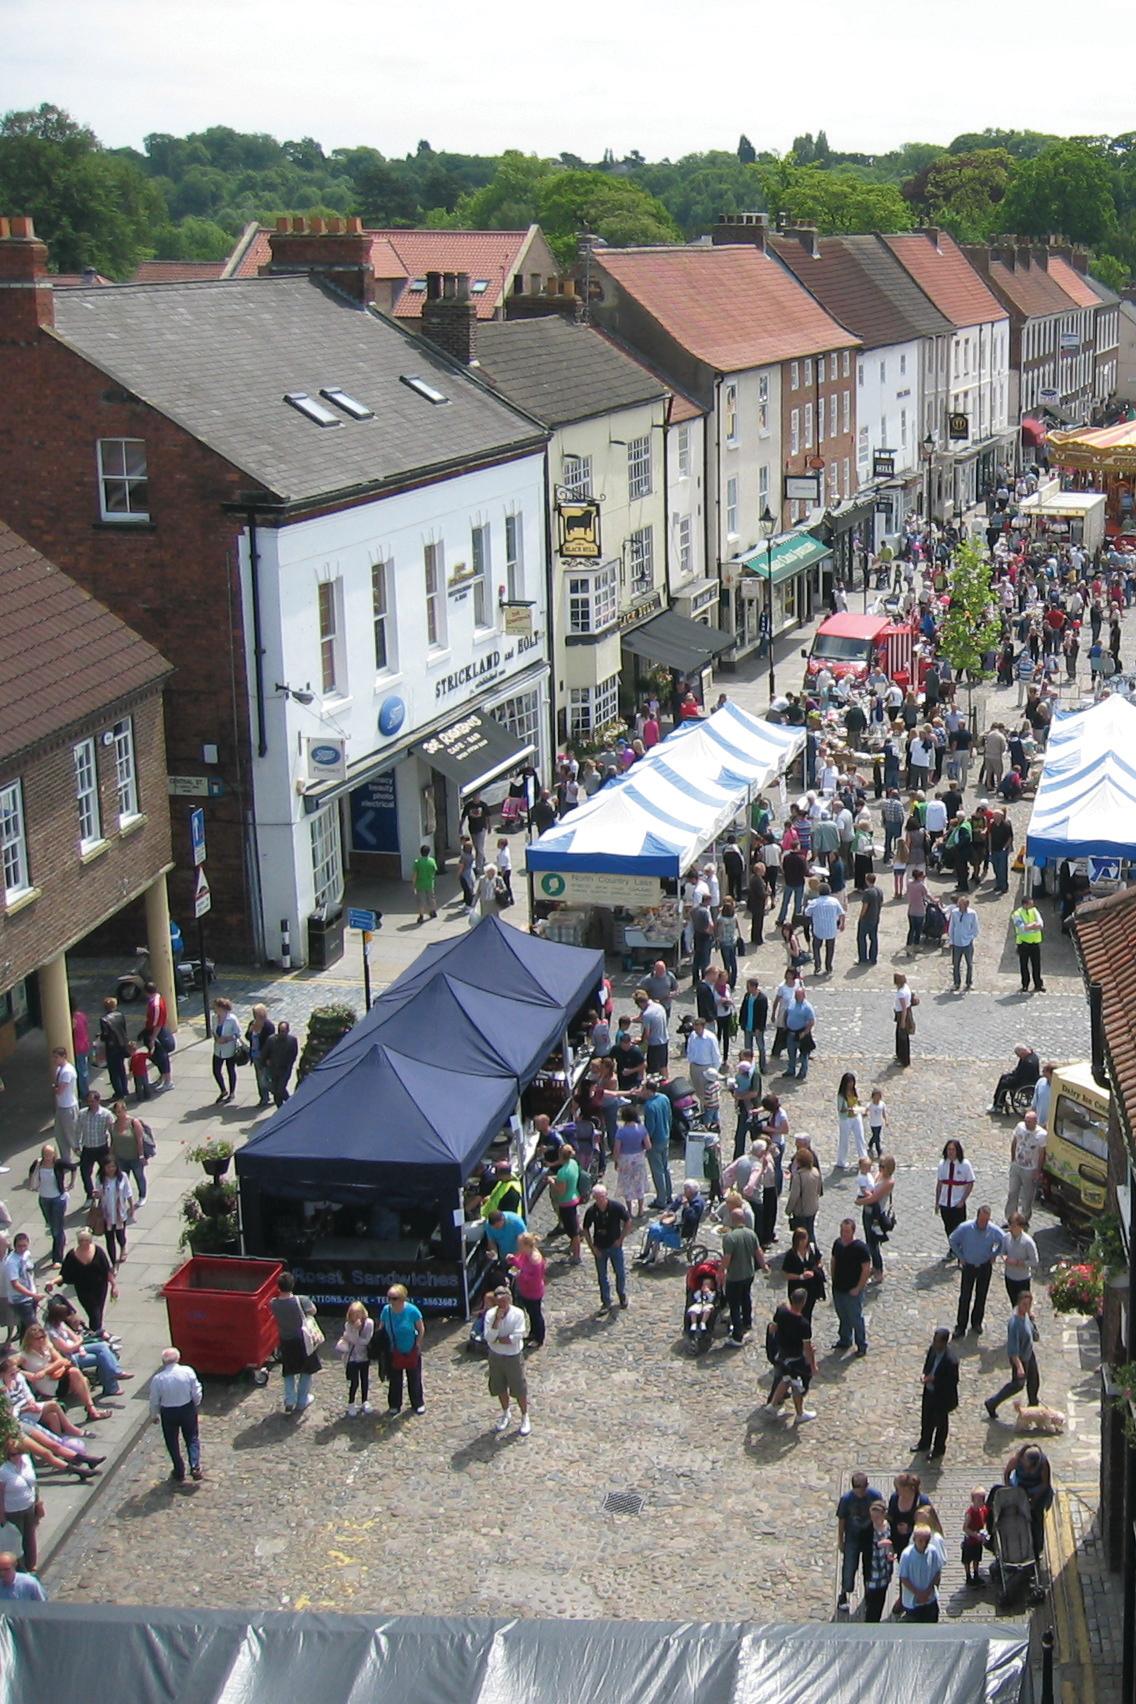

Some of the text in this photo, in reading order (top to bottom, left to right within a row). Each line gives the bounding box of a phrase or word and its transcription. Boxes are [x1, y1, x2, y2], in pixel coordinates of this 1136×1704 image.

[435, 650, 501, 699] STRICKLAND
[517, 630, 540, 655] HOLT
[1062, 1084, 1080, 1100] Dairy
[351, 1269, 459, 1288] Sandwiches
